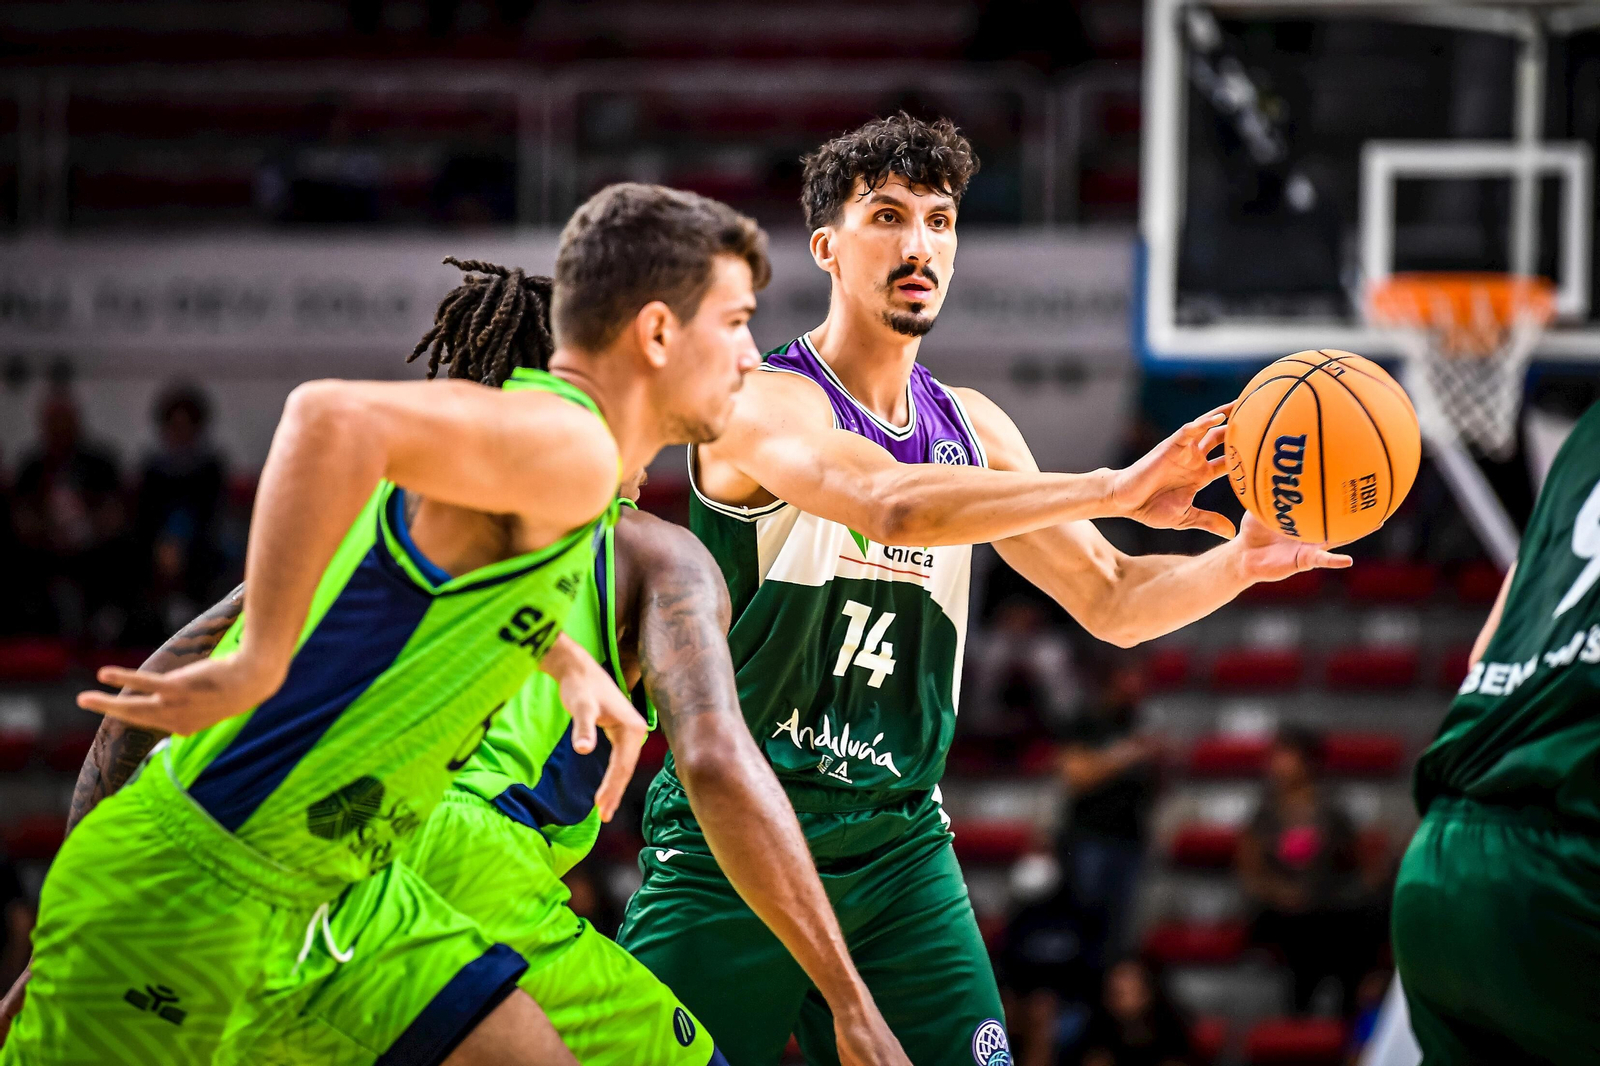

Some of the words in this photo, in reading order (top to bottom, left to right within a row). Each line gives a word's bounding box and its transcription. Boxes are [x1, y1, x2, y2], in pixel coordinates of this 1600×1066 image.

[1271, 434, 1308, 537] Wilson
[1359, 472, 1378, 510] FIBA
[833, 599, 897, 688] 14
[771, 707, 902, 778] Andalucía
